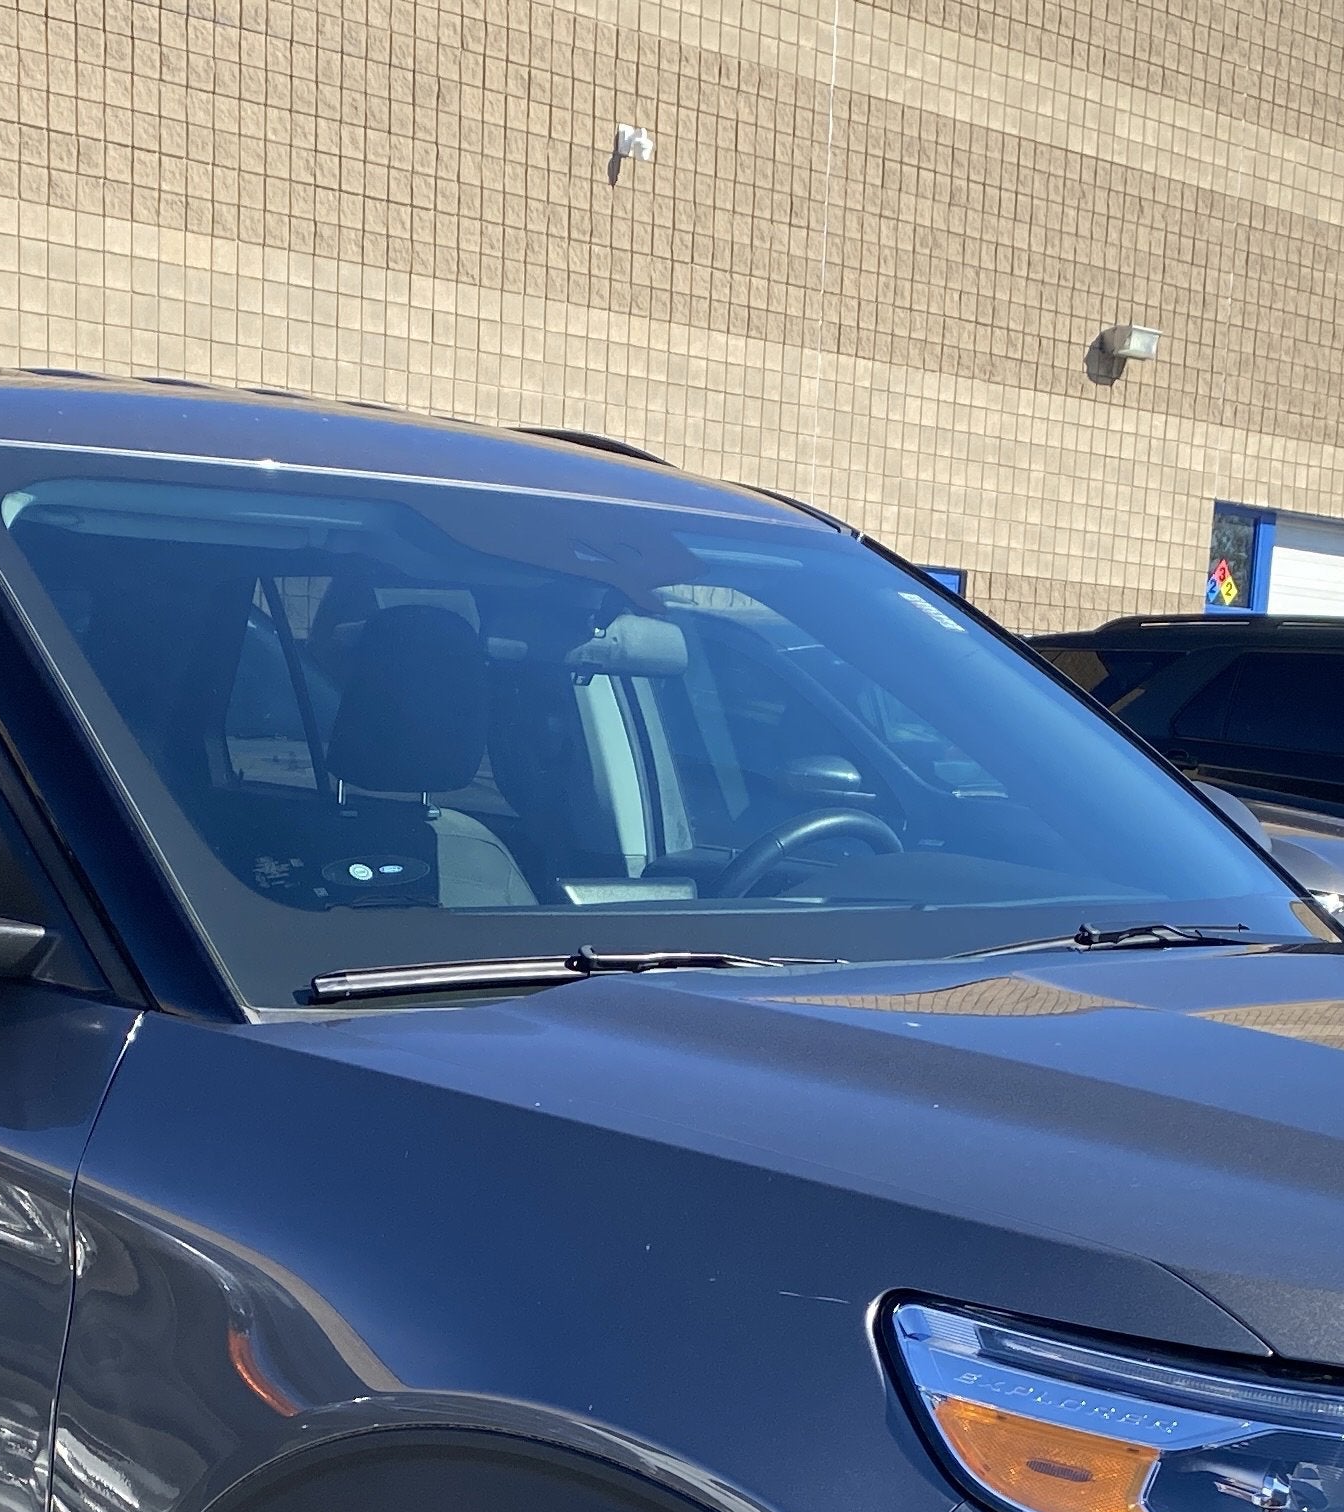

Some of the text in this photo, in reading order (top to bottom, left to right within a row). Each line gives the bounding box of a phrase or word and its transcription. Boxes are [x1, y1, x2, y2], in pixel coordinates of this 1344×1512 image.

[1219, 567, 1226, 581] 3
[1208, 579, 1217, 594] 2
[1224, 581, 1233, 596] 2
